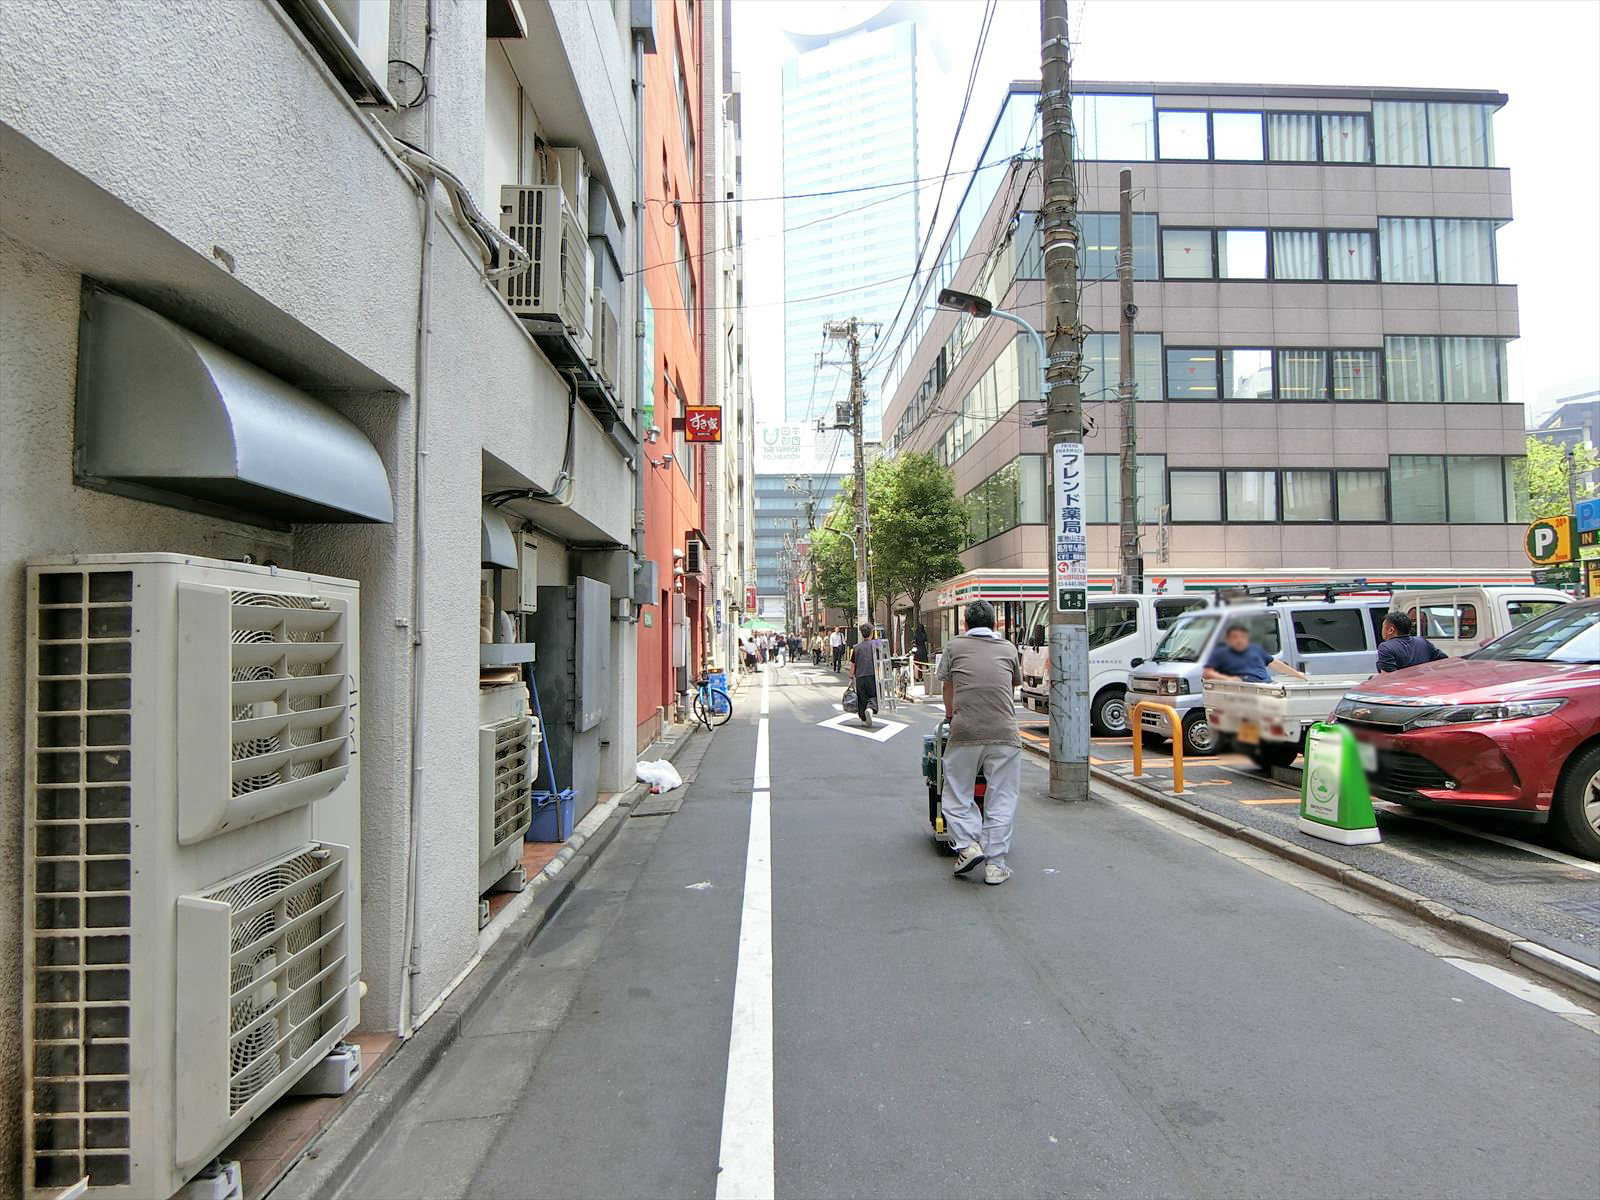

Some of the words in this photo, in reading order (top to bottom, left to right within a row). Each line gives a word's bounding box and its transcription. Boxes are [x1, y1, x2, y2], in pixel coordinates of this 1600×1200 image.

[690, 412, 718, 432] すき家
[1062, 454, 1081, 534] フレンド薬局
[1534, 528, 1553, 556] P
[1582, 532, 1592, 544] IN
